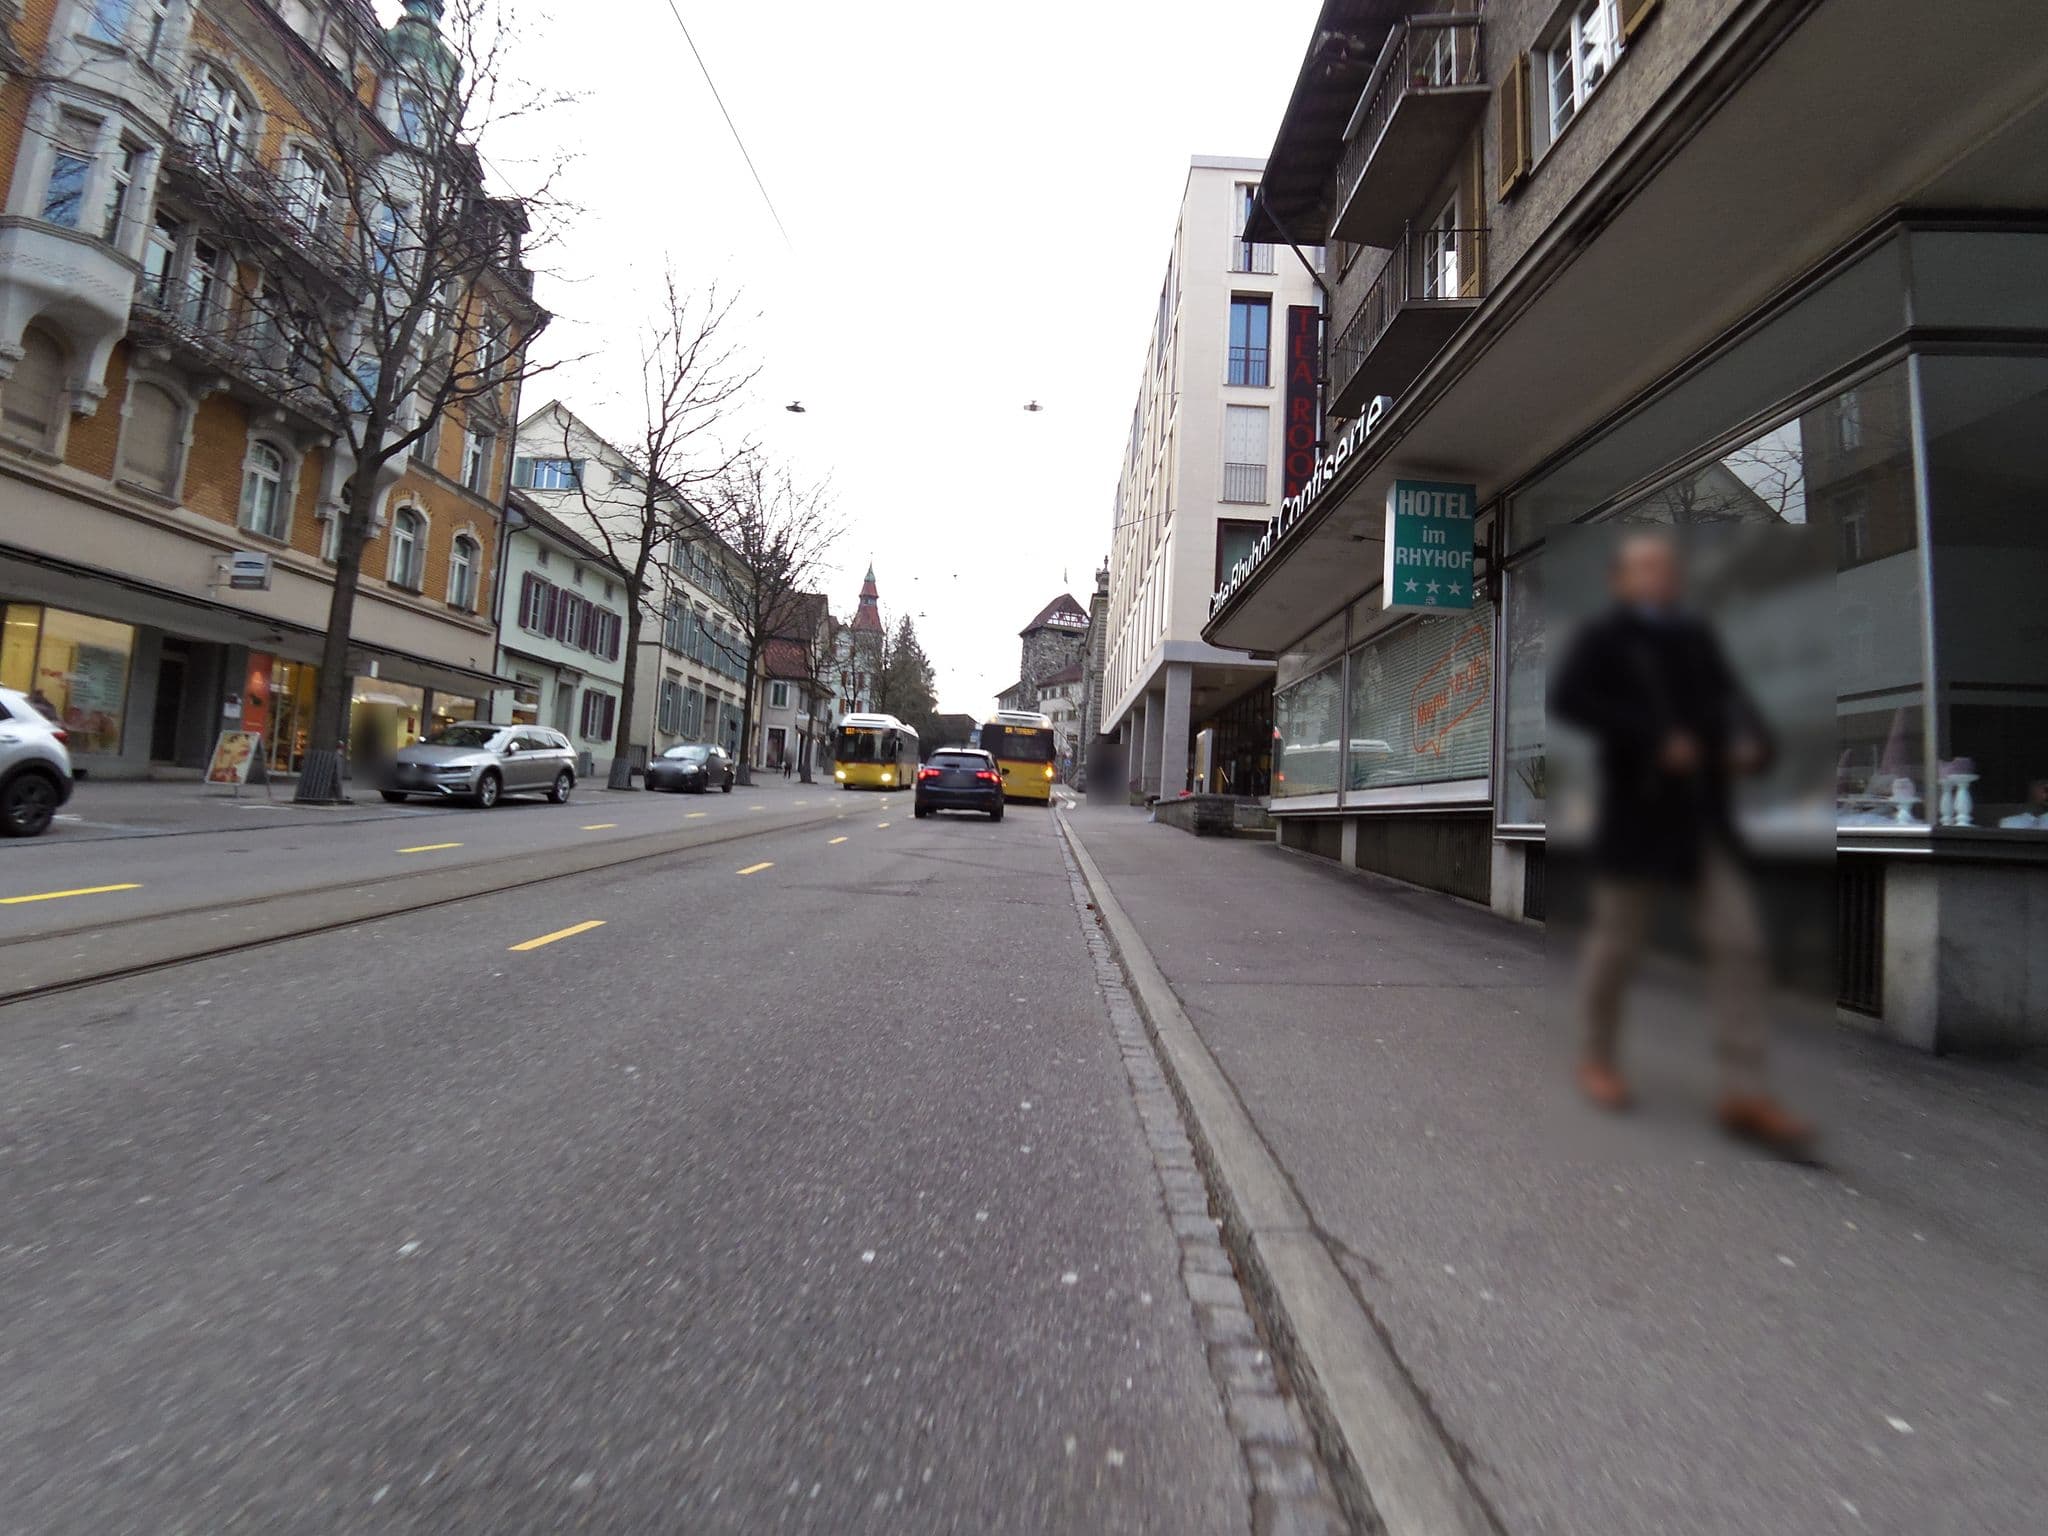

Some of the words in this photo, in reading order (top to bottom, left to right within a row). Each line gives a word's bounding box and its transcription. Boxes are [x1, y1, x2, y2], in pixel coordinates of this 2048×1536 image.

[1293, 307, 1313, 384] TEA
[1276, 395, 1383, 540] Confiserie
[1398, 489, 1473, 520] HOTEL
[1422, 525, 1446, 545] im
[1395, 546, 1473, 570] RHYHOF
